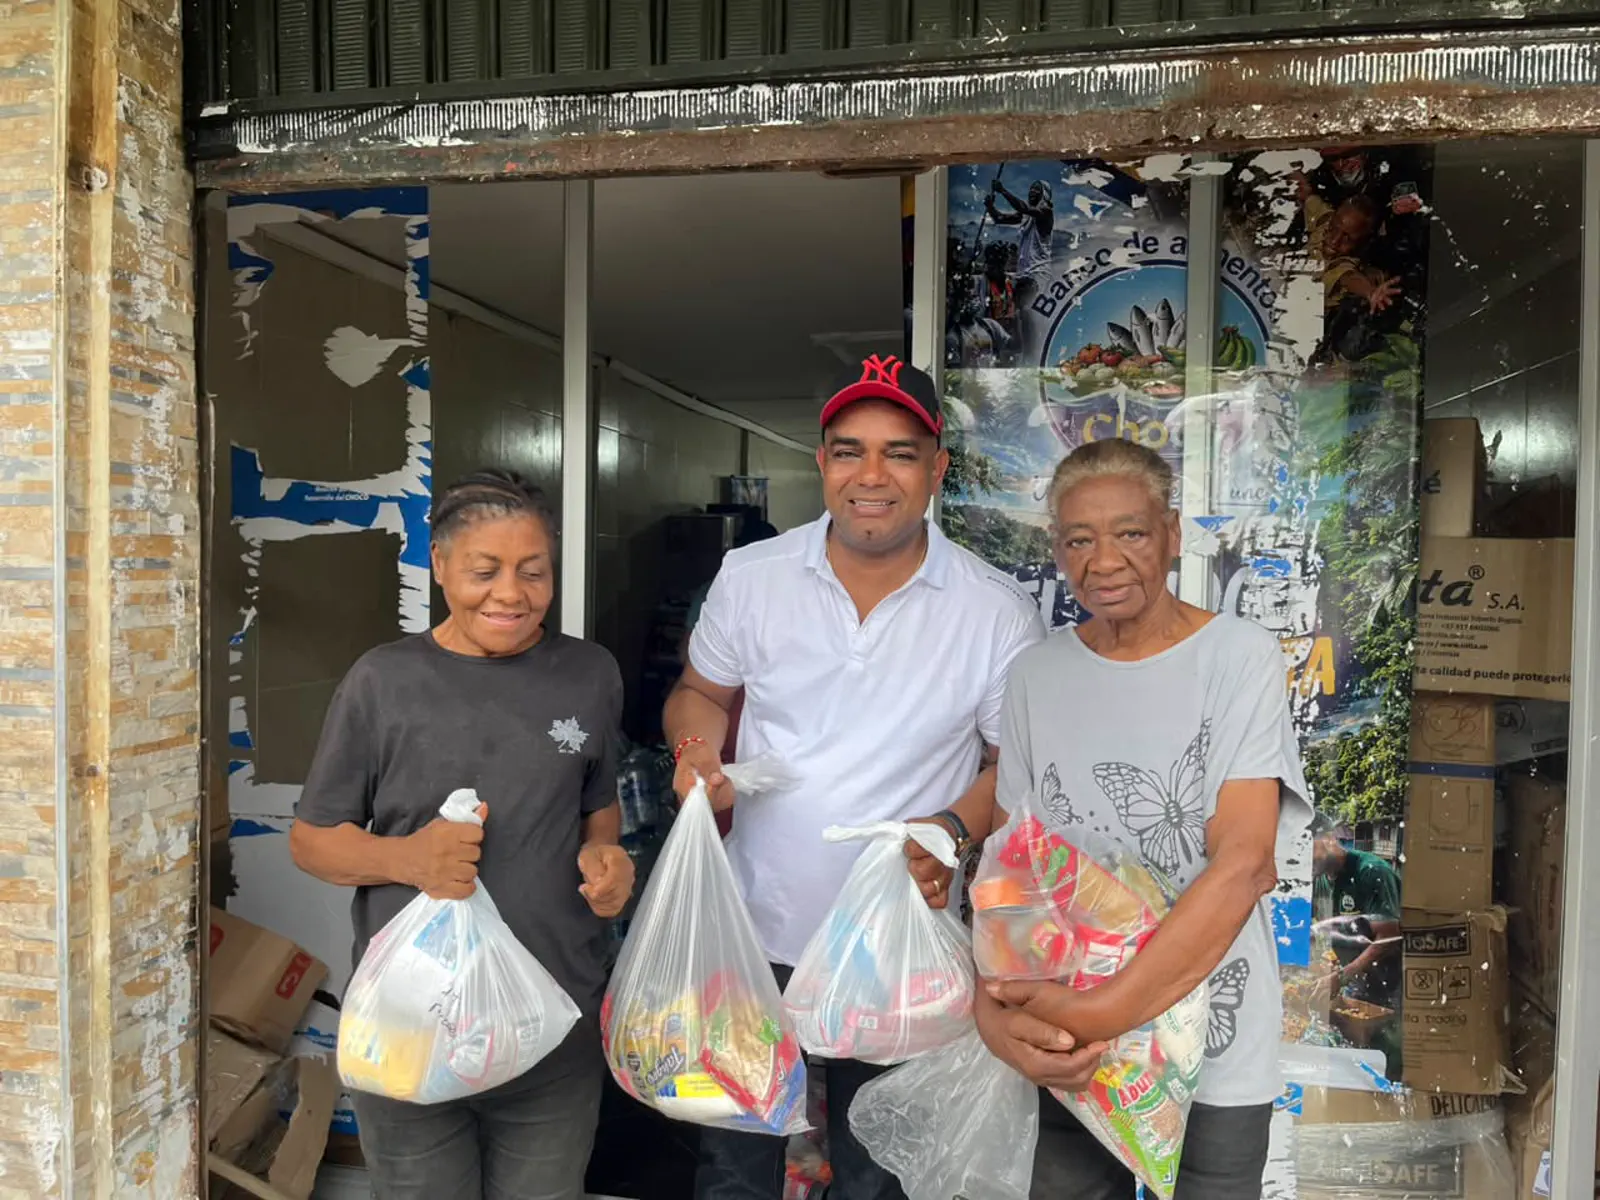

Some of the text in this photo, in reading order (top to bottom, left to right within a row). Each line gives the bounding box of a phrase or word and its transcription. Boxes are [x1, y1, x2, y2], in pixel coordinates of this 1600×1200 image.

[1123, 231, 1160, 257] de
[1487, 593, 1526, 611] S.A.
[1429, 666, 1471, 678] calidad
[1474, 670, 1510, 681] puede
